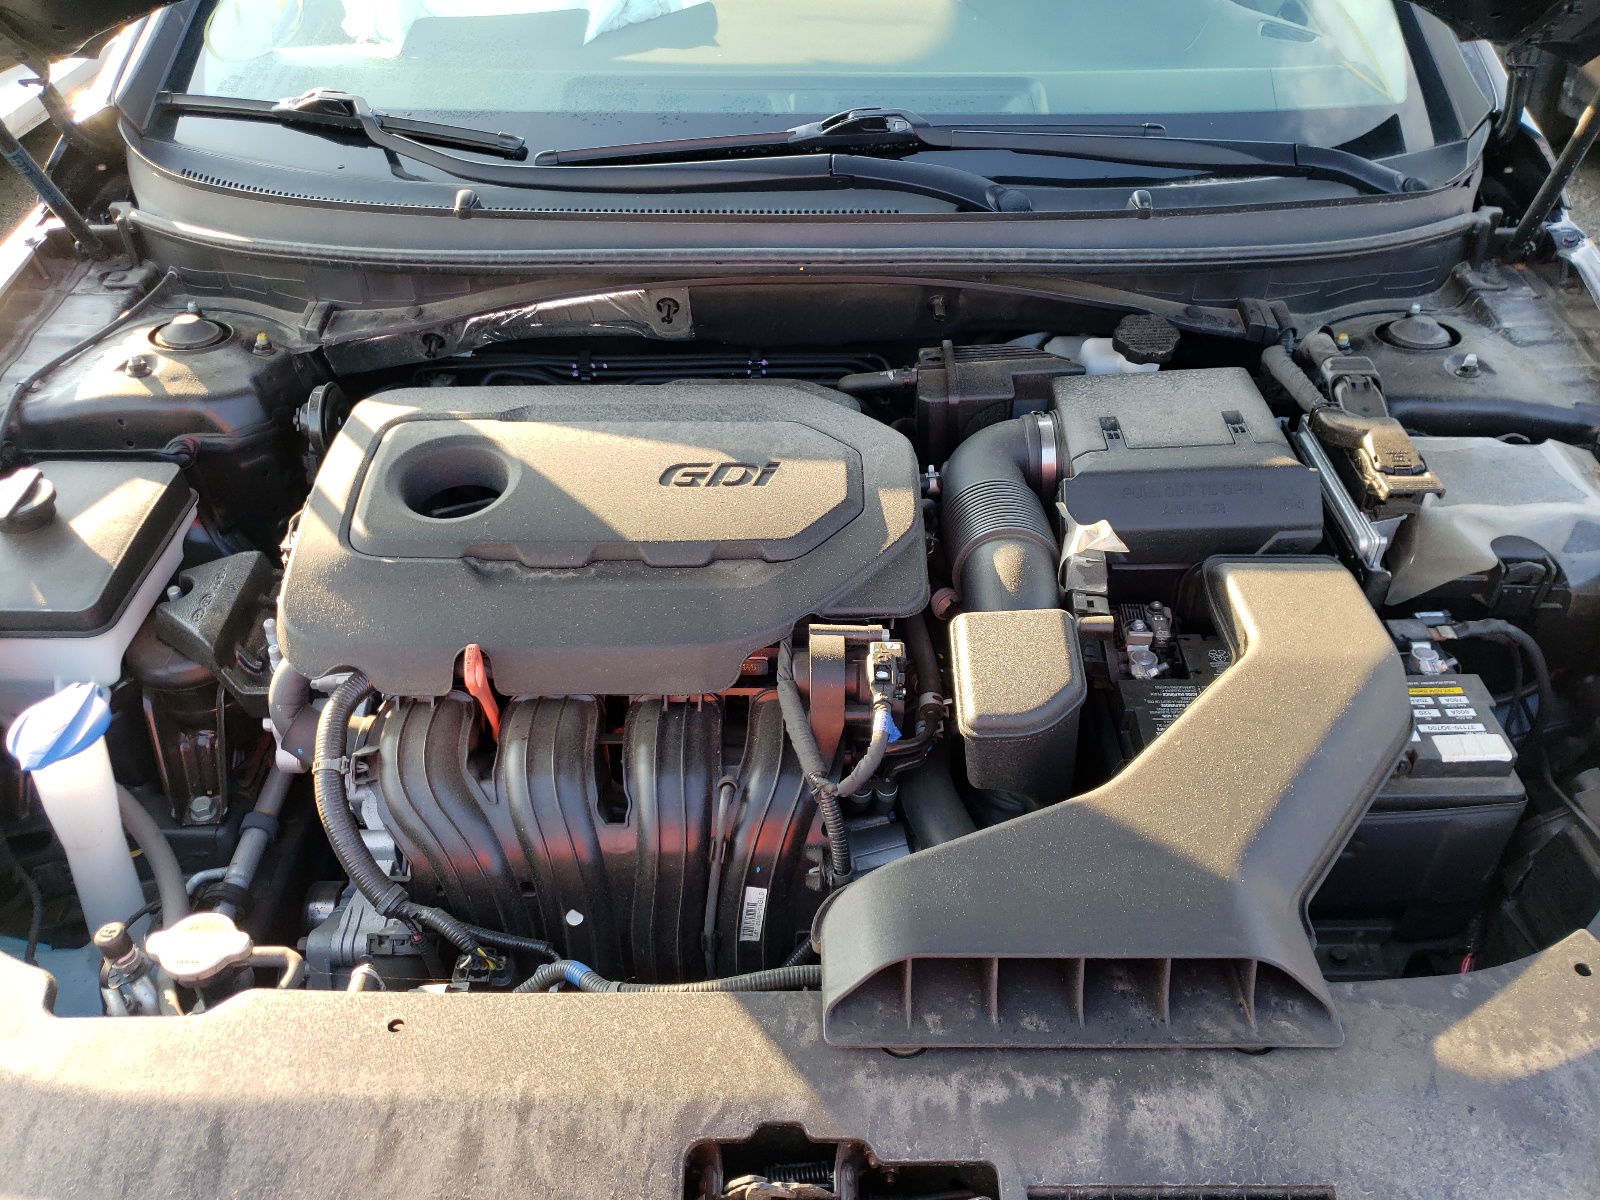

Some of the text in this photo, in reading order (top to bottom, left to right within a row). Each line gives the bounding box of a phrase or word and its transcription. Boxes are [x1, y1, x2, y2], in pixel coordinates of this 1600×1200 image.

[658, 461, 782, 488] GDi
[1122, 486, 1162, 499] PULL
[1163, 485, 1195, 498] OUT
[1222, 482, 1264, 496] OPEN
